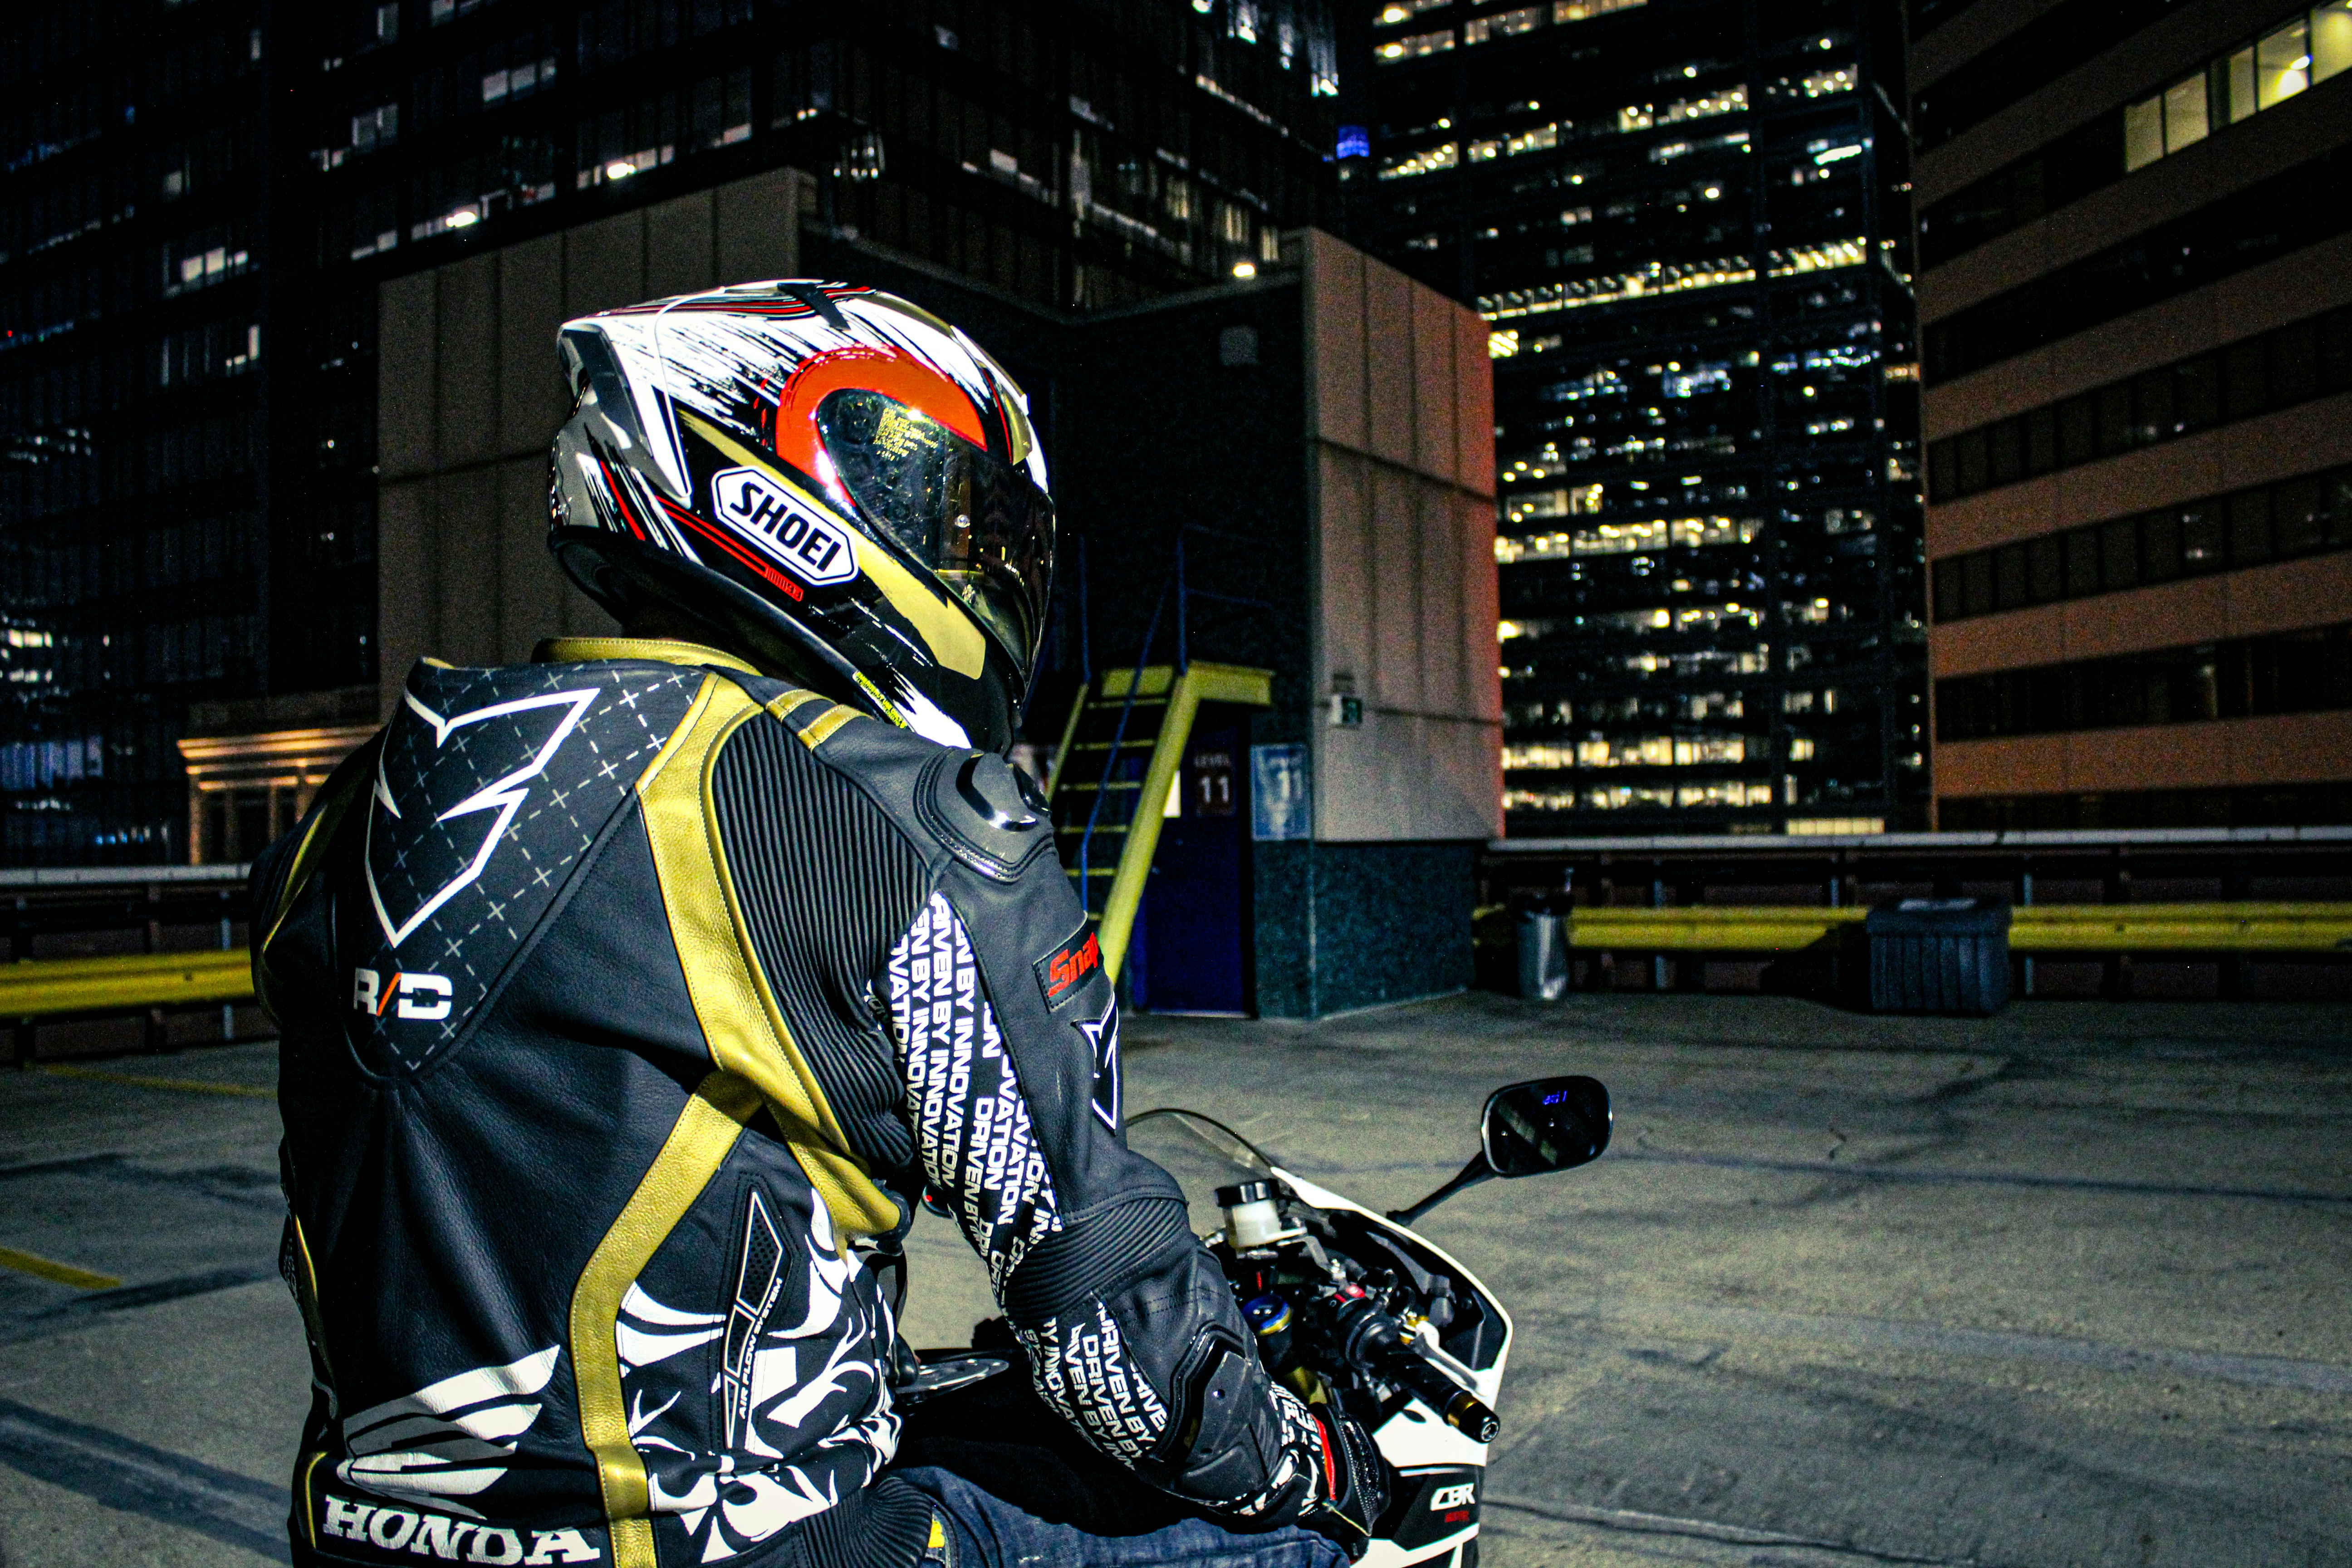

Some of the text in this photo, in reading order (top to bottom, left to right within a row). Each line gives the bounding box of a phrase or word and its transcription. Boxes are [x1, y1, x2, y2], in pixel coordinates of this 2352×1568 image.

[730, 483, 841, 572] SHOEI
[1199, 776, 1229, 803] 11
[911, 958, 931, 1003] BY
[956, 967, 975, 1013] BY
[931, 1000, 952, 1045] BY
[942, 1017, 974, 1188] INNOVATION
[964, 1098, 995, 1203] DRIVEN
[964, 1200, 979, 1228] BY
[739, 1277, 783, 1420] AIR FLOW SYSTEM
[1083, 1334, 1128, 1437] DRIVEN
[1083, 1411, 1112, 1440] BY
[1124, 1416, 1156, 1442] BY
[1430, 1482, 1475, 1511] CBR
[323, 1494, 601, 1566] HONDA
